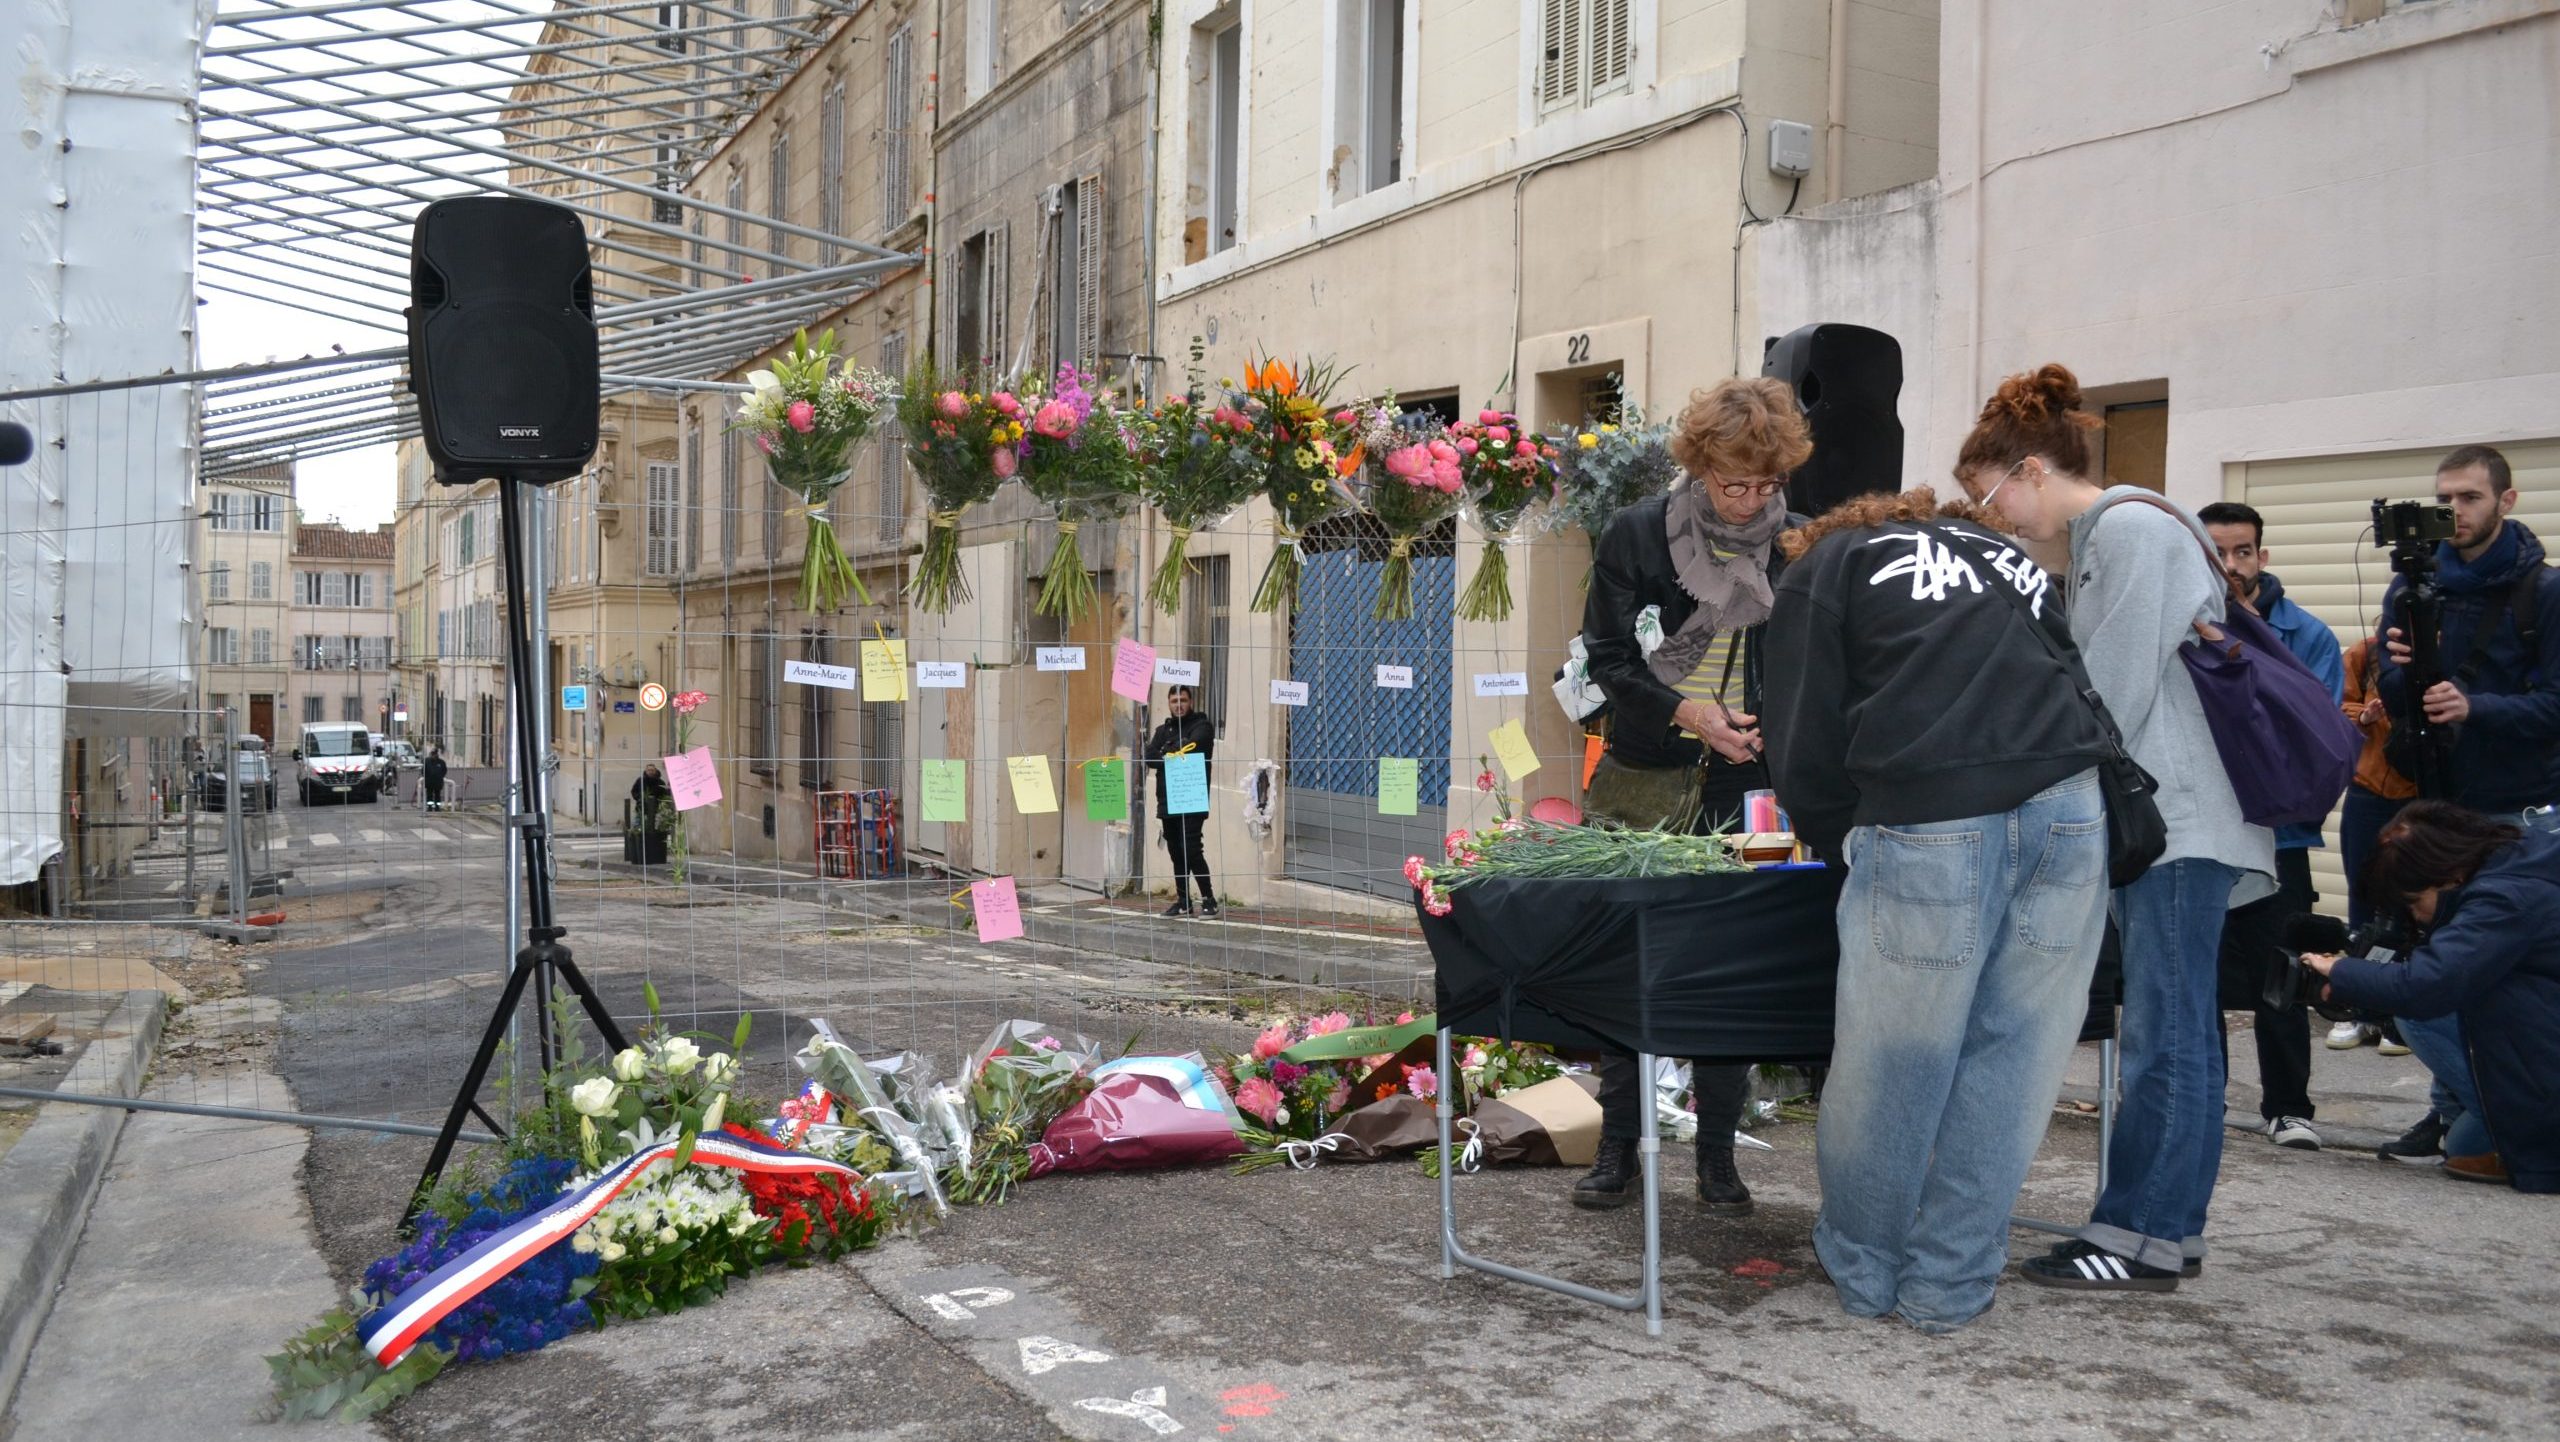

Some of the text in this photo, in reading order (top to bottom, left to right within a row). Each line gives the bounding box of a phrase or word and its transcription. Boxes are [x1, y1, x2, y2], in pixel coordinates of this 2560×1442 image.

[1567, 333, 1590, 365] 22
[499, 428, 540, 437] VONYX
[1044, 653, 1078, 664] Michaël
[792, 665, 848, 681] Anne-Marie
[923, 667, 958, 680] Jacques
[1161, 665, 1192, 677] Marion
[1384, 671, 1405, 682] Anna
[1481, 678, 1520, 689] Antonietta
